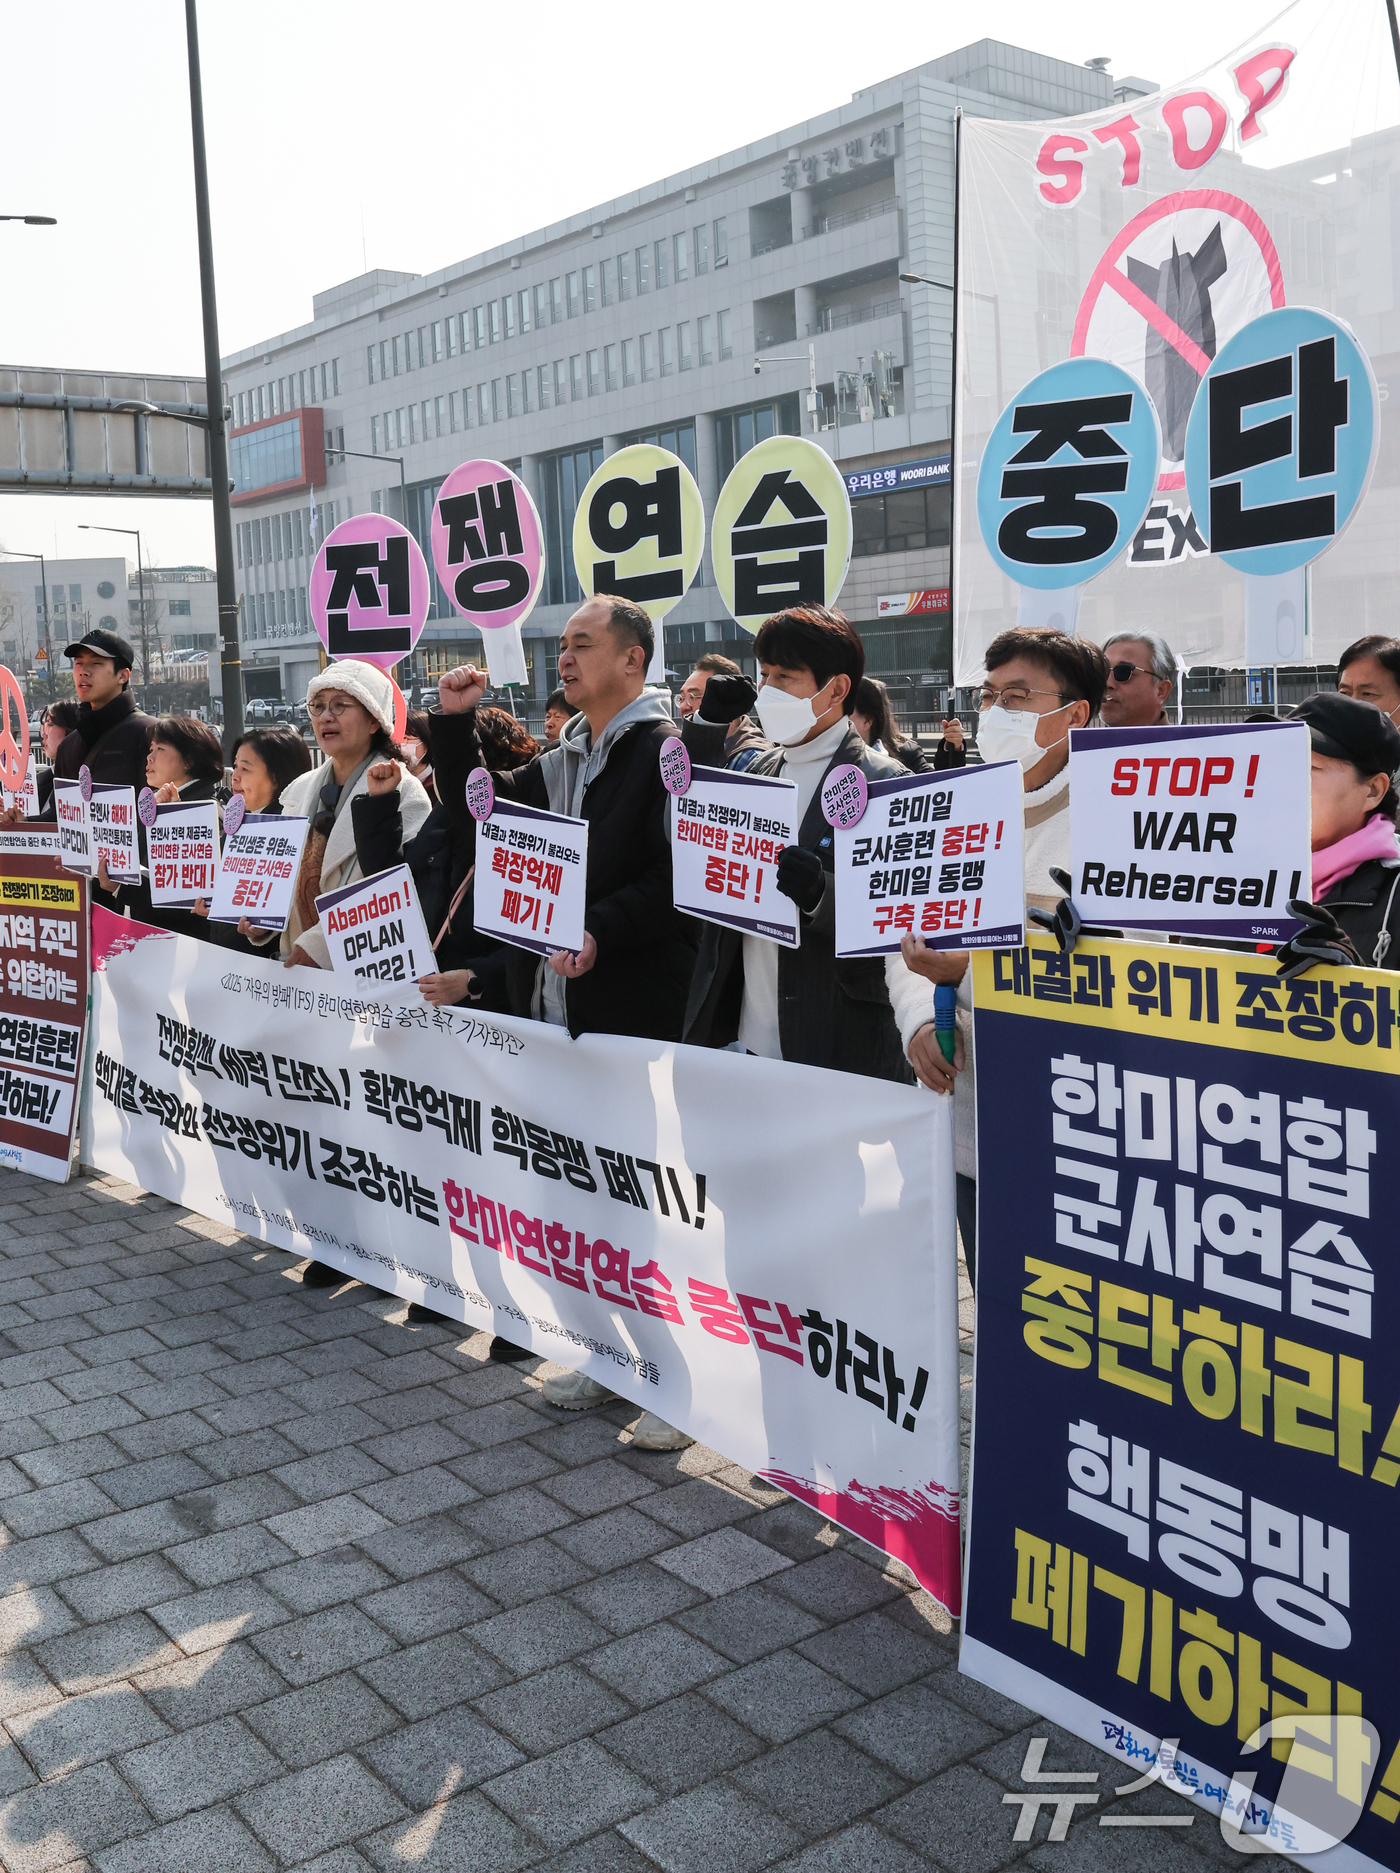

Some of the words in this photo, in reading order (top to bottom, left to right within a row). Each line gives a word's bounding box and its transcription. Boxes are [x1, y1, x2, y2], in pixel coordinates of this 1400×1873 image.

[1036, 47, 1295, 204] STOP
[781, 127, 889, 190] 국방컨벤션
[1208, 334, 1350, 554] 단
[848, 469, 897, 492] 우리은행
[900, 467, 926, 481] WOORI
[927, 463, 950, 477] BANK
[1000, 392, 1136, 566] 중
[440, 478, 531, 614] 쟁
[588, 465, 684, 604] 연
[731, 469, 828, 617] 습
[325, 536, 411, 656] 전
[661, 745, 684, 768] 한미연합
[664, 760, 687, 781] 군사연습
[467, 776, 489, 794] 한미연합
[671, 775, 687, 791] 중단!
[823, 770, 857, 804] 한미연합
[1111, 757, 1235, 797] STOP
[90, 802, 109, 823] 유엔사
[469, 790, 489, 807] 군사연습
[827, 786, 861, 818] 군사연습
[839, 801, 860, 825] 중단!
[888, 791, 954, 827] 한미일
[93, 826, 133, 847] 전시작전통제권
[150, 826, 170, 841] 유엔사
[171, 826, 185, 840] 전력
[186, 826, 213, 840] 제공국의
[677, 797, 706, 819] 대결과
[708, 803, 751, 830] 전쟁위기
[753, 816, 790, 839] 불러오는
[677, 818, 729, 852] 한미연합
[1133, 811, 1237, 853] WAR
[27, 837, 39, 848] 중단
[41, 837, 53, 848] 촉구
[61, 827, 89, 856] OPCON
[151, 843, 179, 859] 한미연합
[181, 843, 213, 859] 군사연습
[228, 835, 267, 855] 주민생존
[266, 837, 298, 857] 위협하는
[482, 821, 507, 843] 대결과
[508, 829, 547, 855] 전쟁위기
[548, 843, 580, 864] 불러오는
[851, 829, 936, 867] 군사훈련
[155, 864, 178, 889] 참가
[222, 856, 257, 875] 한미연합
[256, 859, 293, 879] 군사연습
[492, 847, 563, 896] 확장억제
[869, 866, 932, 899] 한미일
[938, 860, 986, 894] 동맹
[1080, 861, 1278, 908] Rehearsal
[2, 882, 39, 900] 전쟁위기
[41, 884, 75, 903] 조장하며
[39, 918, 78, 958] 주민
[873, 903, 915, 935] 구축
[1251, 926, 1279, 936] SPARK
[343, 919, 405, 962] OPLAN
[961, 933, 1018, 945] 평화와통일을여는사람들
[7, 958, 78, 1005] 위협하는
[993, 948, 1115, 1009] 대결과
[1127, 959, 1219, 1024] 위기
[1235, 971, 1400, 1049] 조장하
[318, 993, 393, 1029] 한미연합연습
[395, 1006, 428, 1029] 중단
[432, 1007, 453, 1035] 촉구
[156, 1013, 223, 1080] 전쟁획책
[219, 1043, 272, 1097] 세력
[359, 1069, 482, 1156] 확장억제
[491, 1104, 597, 1193] 핵동맹
[1050, 1053, 1377, 1219] 한미연합
[95, 1050, 143, 1116] 핵대결
[201, 1102, 317, 1181] 전쟁위기
[319, 1137, 440, 1227] 조장하는
[442, 1177, 685, 1326] 한미연합연습
[1053, 1156, 1375, 1339] 군사연습
[1067, 1418, 1352, 1650] 핵동맹
